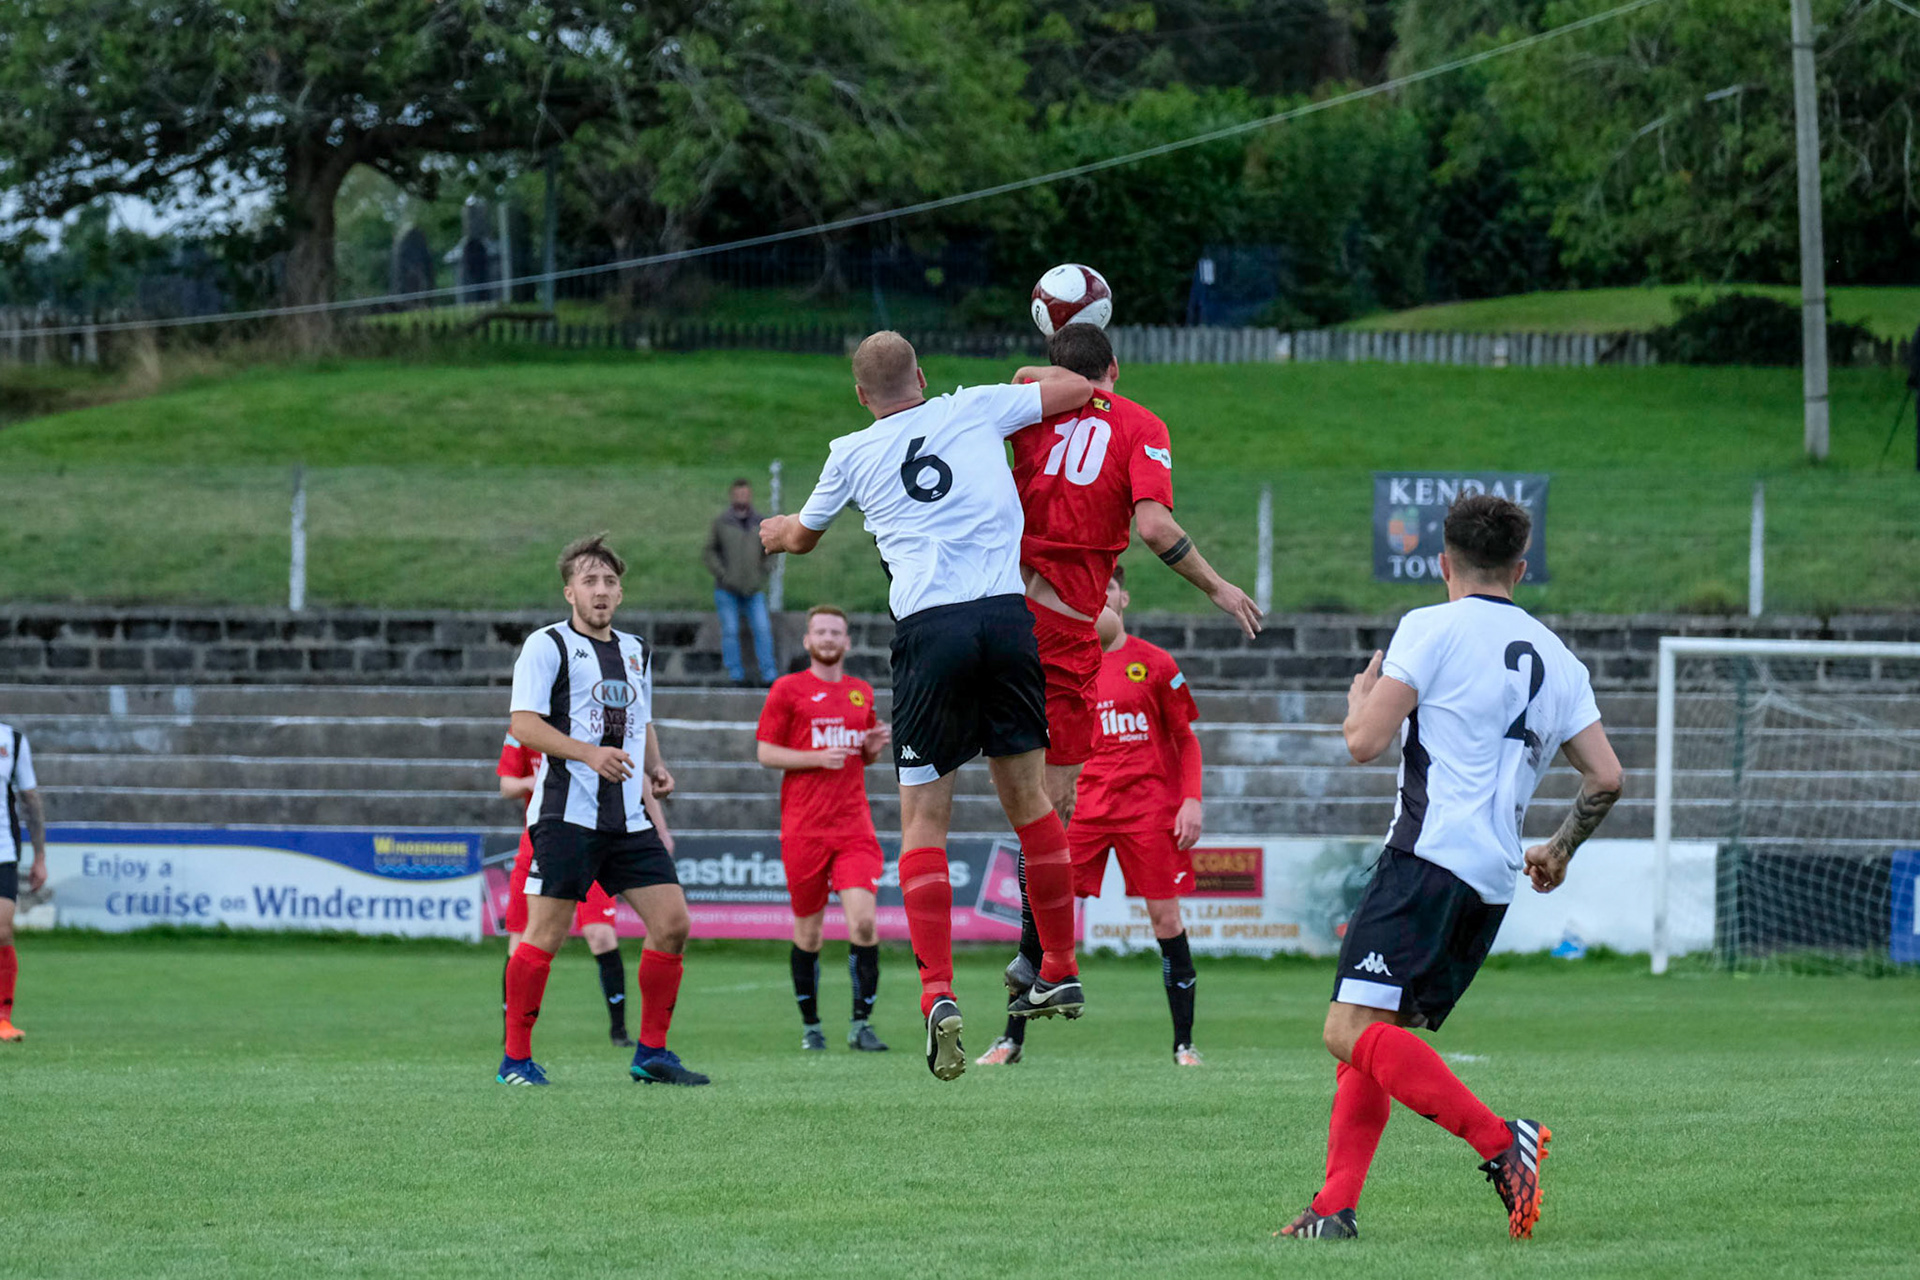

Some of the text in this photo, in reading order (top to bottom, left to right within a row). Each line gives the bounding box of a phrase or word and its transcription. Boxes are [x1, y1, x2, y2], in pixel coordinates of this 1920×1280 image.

[1044, 416, 1111, 486] 10
[901, 435, 953, 503] 6
[1389, 477, 1533, 507] KENDAL
[1387, 555, 1444, 579] TOW
[601, 684, 629, 703] KIA
[1503, 640, 1545, 748] 2
[1100, 709, 1149, 736] ilne
[82, 852, 172, 882] Enjoy a
[676, 851, 788, 886] astria
[1193, 853, 1258, 873] COAST
[105, 885, 472, 920] cruise on Windermere
[1092, 924, 1154, 939] CHARTE
